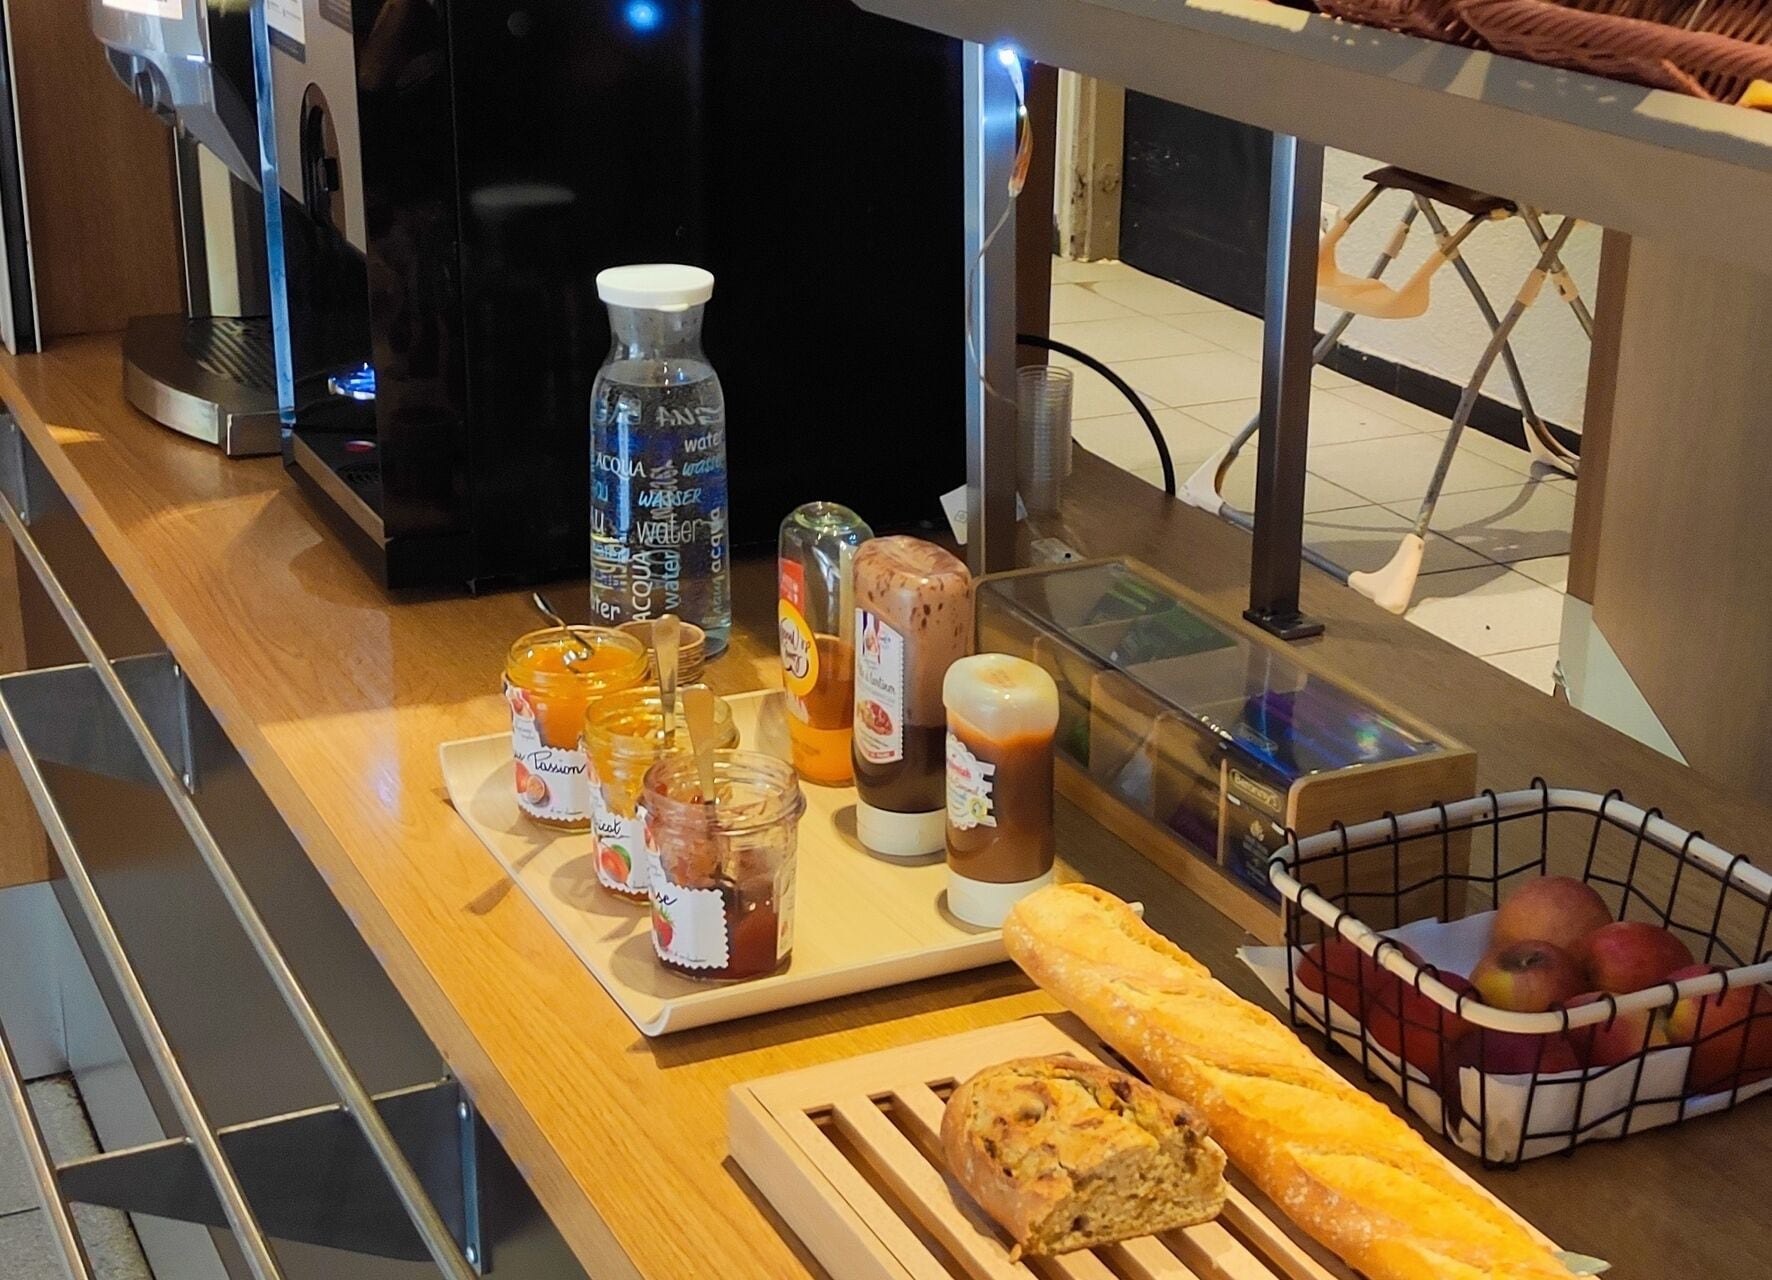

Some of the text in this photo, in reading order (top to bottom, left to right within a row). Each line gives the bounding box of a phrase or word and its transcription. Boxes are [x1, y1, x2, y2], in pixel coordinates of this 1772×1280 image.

[595, 451, 647, 480] ACQUA
[638, 487, 702, 508] WASSER
[636, 513, 704, 544] water
[710, 507, 723, 573] acqua
[631, 549, 654, 621] ACQUA
[662, 549, 681, 610] water
[527, 750, 587, 775] Passion
